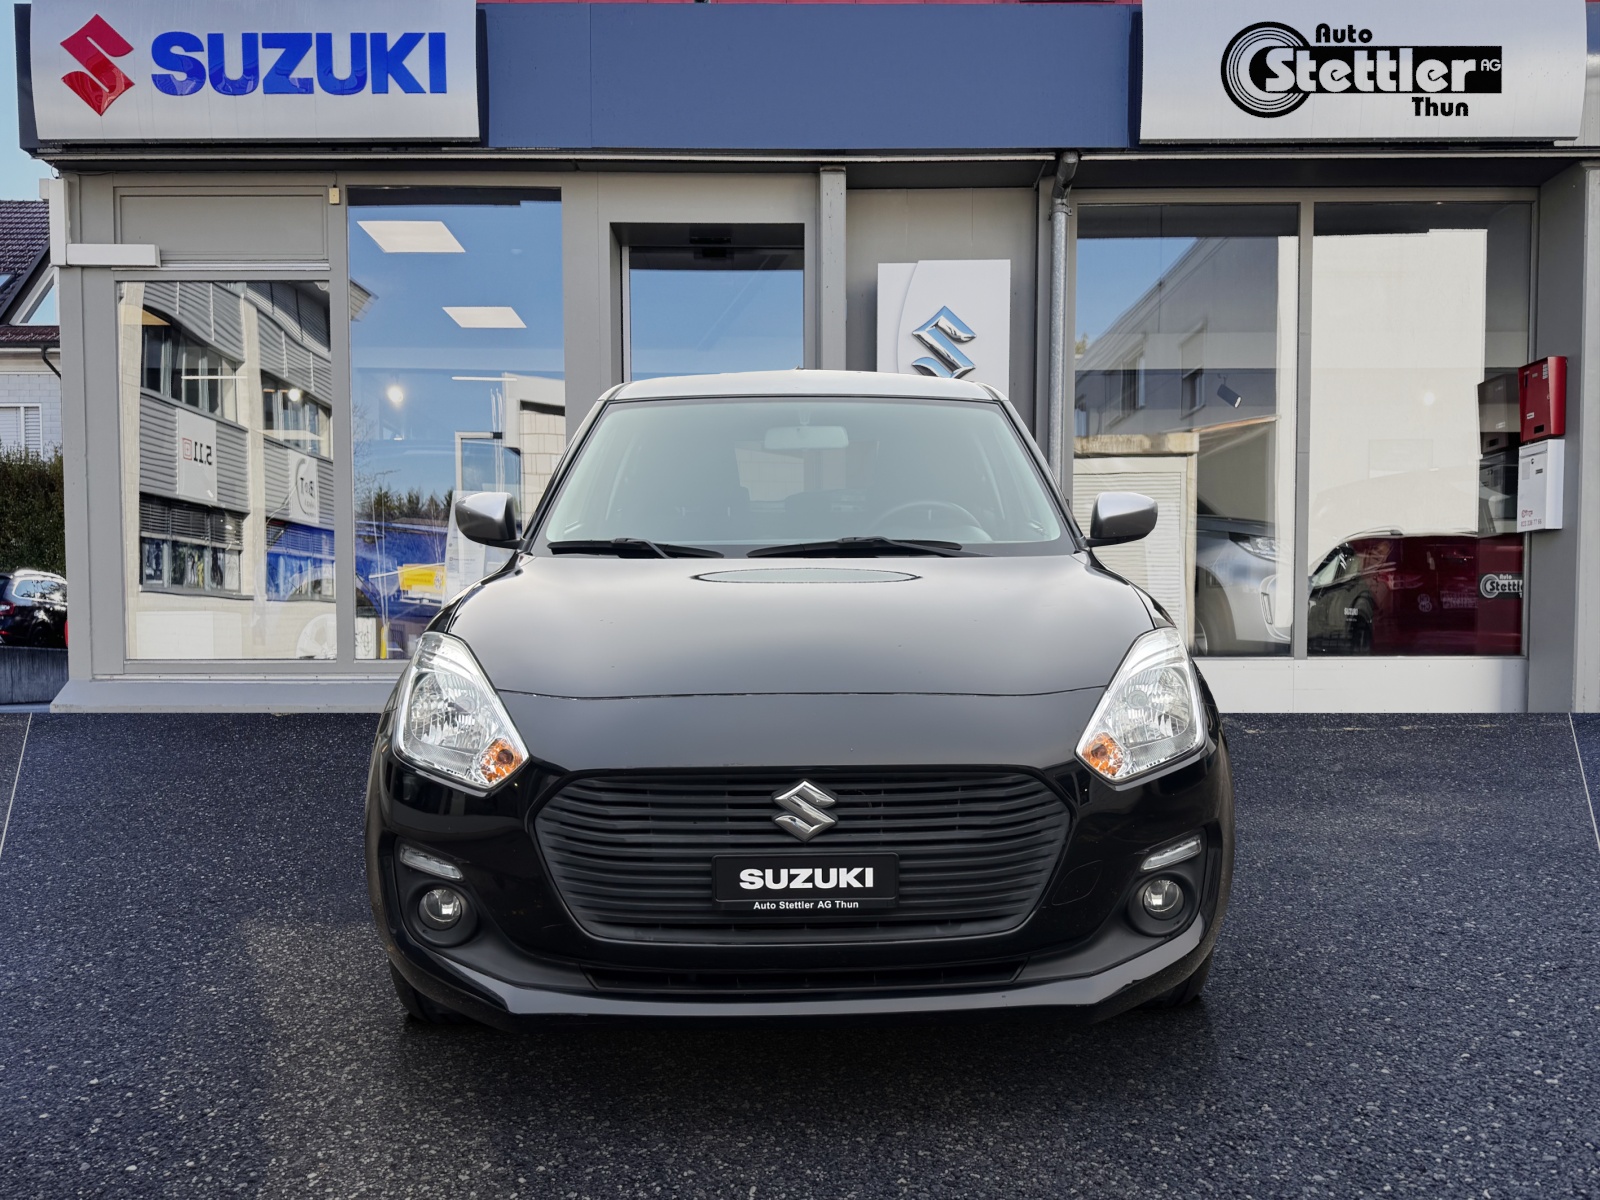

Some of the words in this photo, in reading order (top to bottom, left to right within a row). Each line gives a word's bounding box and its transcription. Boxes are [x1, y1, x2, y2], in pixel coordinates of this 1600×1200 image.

[1315, 23, 1373, 44] Auto
[151, 31, 447, 96] SUZUKI
[1266, 47, 1477, 93] Stettler
[1480, 58, 1501, 72] AG
[1411, 97, 1469, 117] Thun
[739, 867, 874, 890] SUZUKI
[753, 900, 776, 910] Auto
[779, 900, 814, 910] Stettler
[817, 900, 832, 910] AG
[834, 900, 859, 910] Thun
